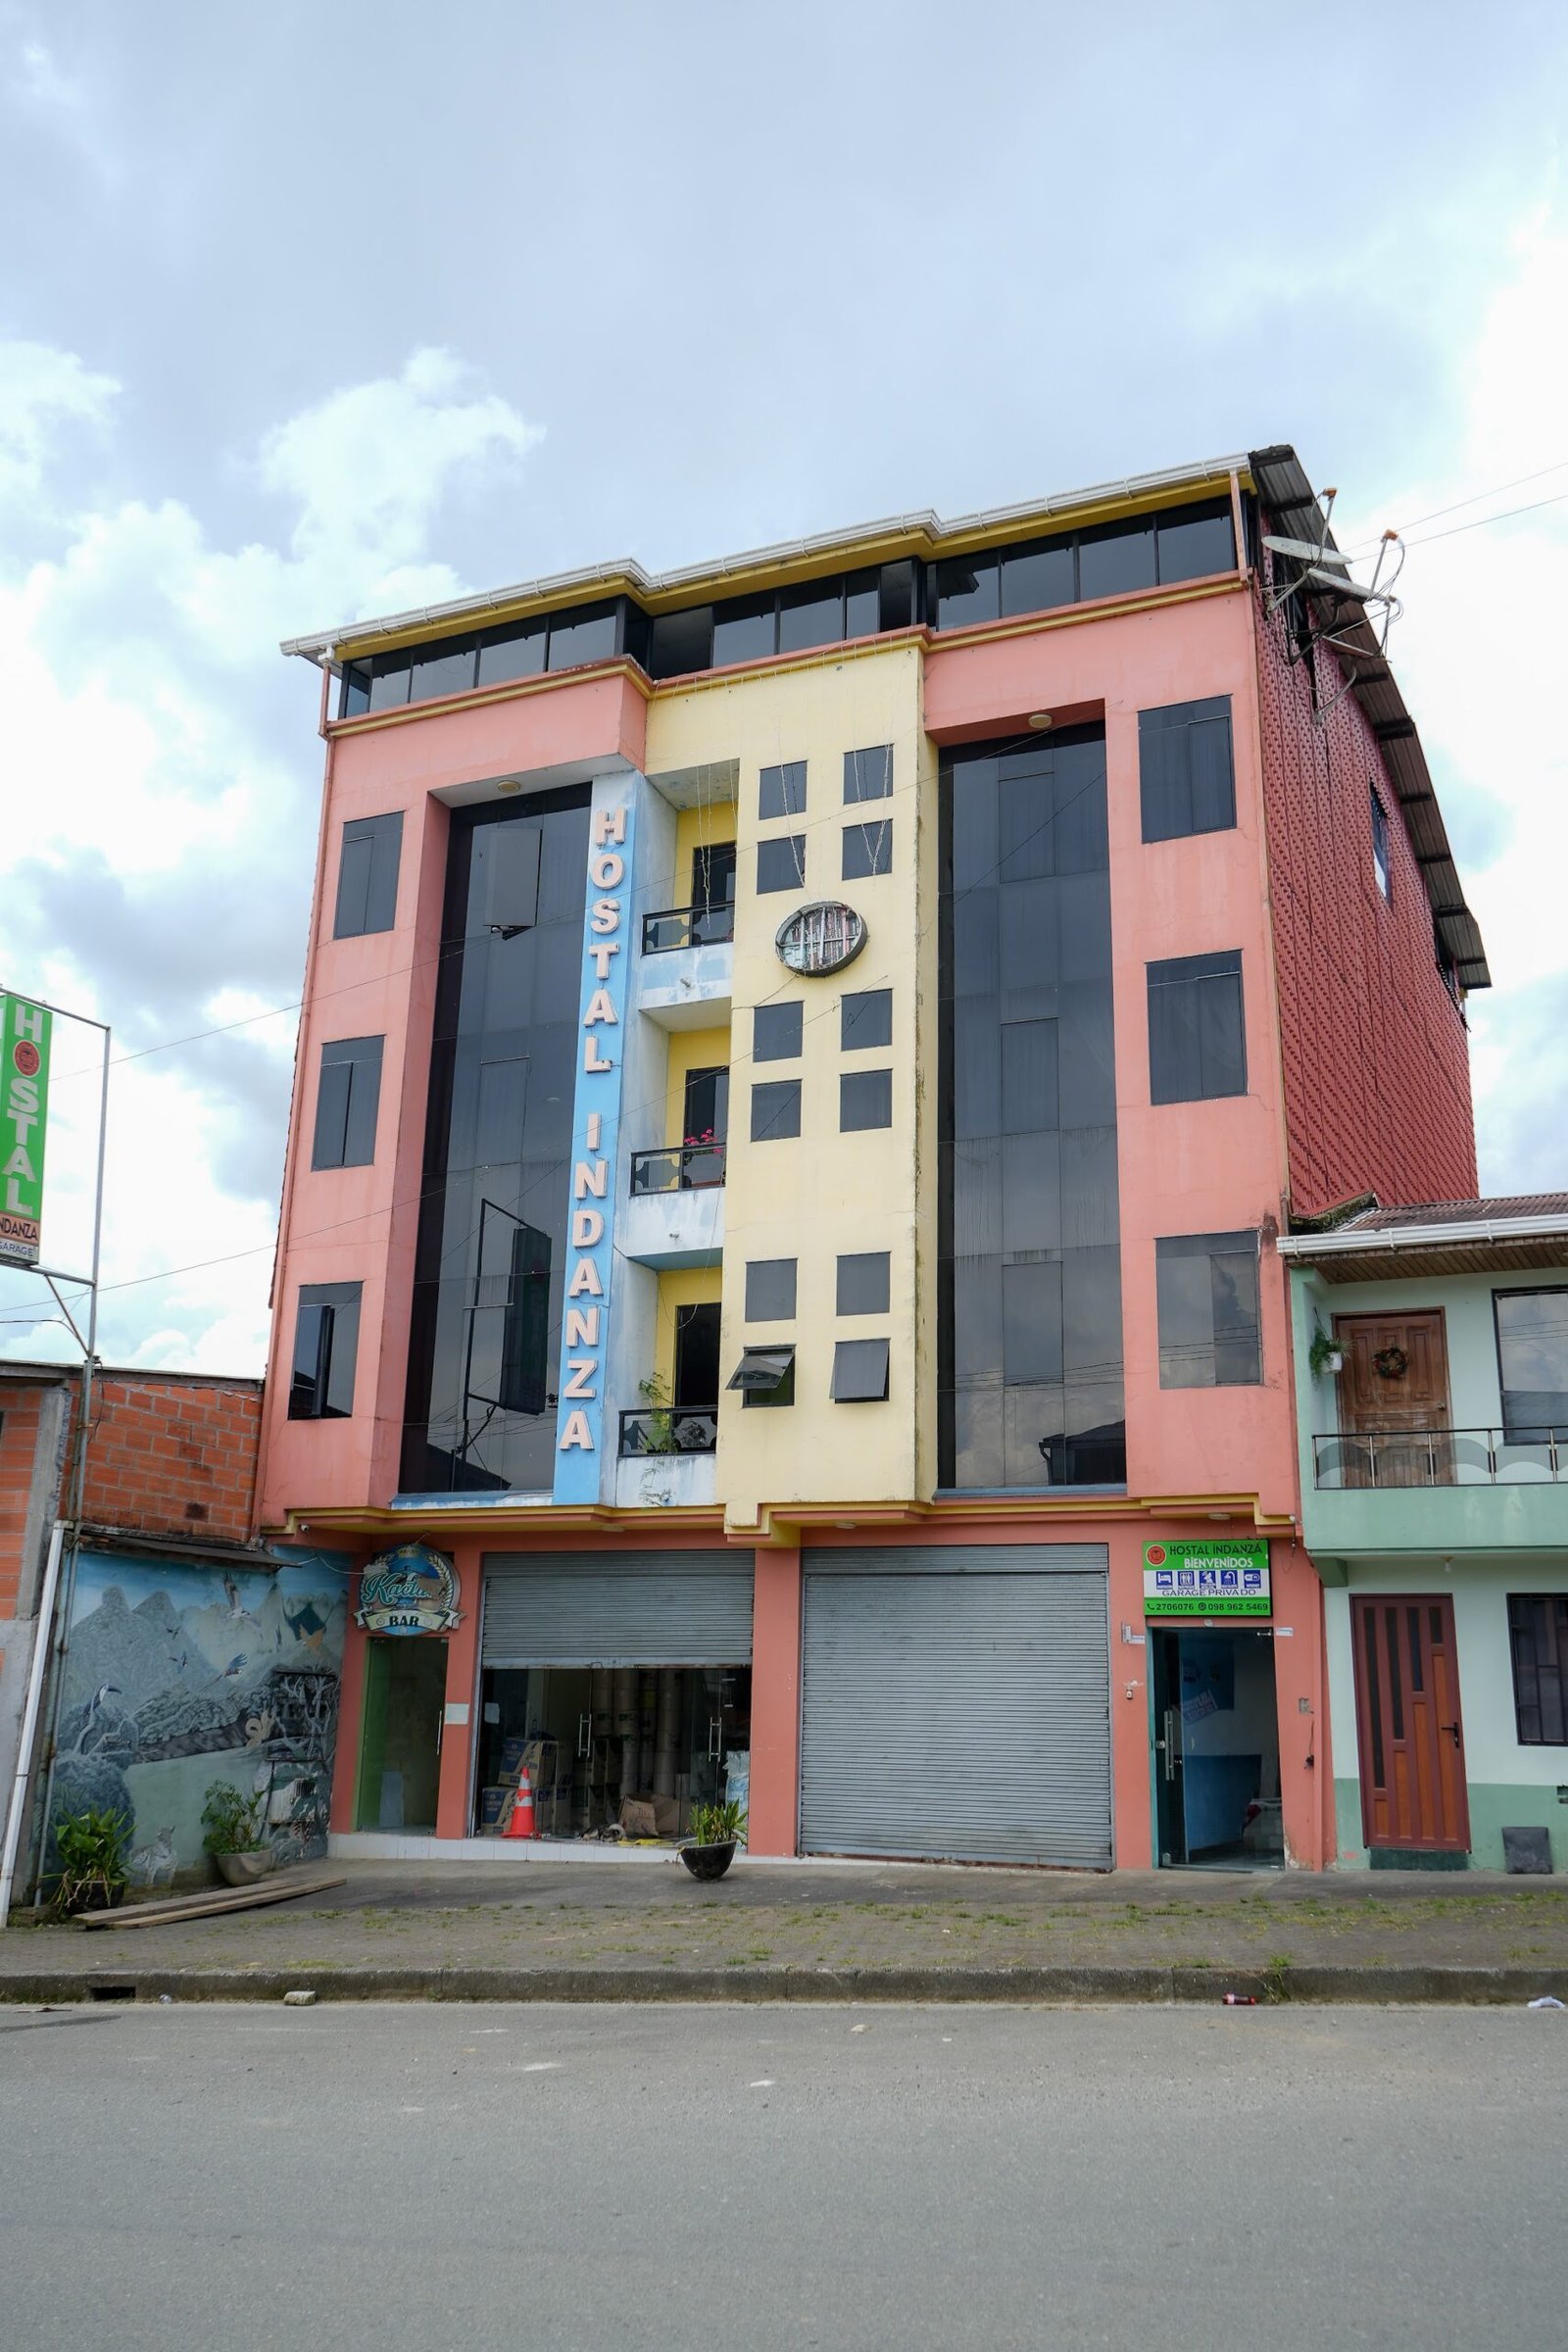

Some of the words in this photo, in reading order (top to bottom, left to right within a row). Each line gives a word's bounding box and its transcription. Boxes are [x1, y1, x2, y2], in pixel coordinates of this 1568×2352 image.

[583, 807, 628, 1074] HOSTAL
[559, 1112, 608, 1451] INDANZA
[1169, 1544, 1209, 1555] HOSTAL
[389, 1615, 419, 1627] BAR
